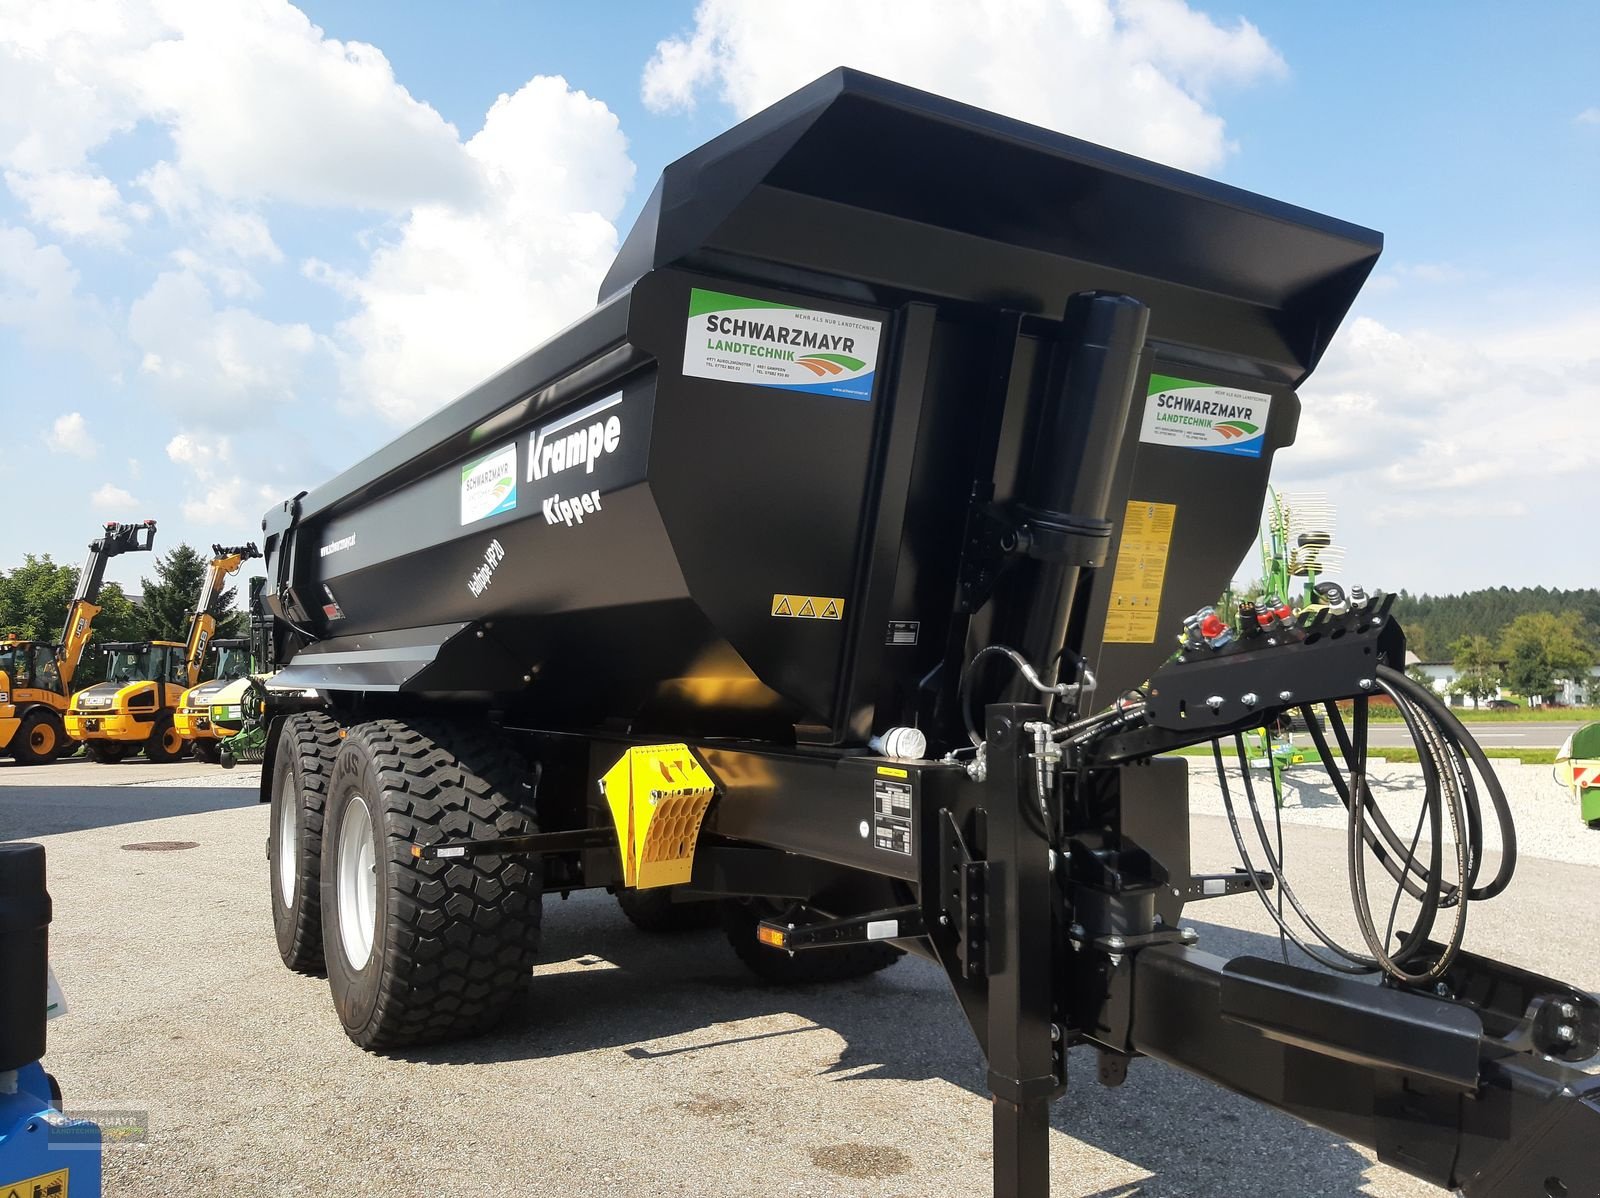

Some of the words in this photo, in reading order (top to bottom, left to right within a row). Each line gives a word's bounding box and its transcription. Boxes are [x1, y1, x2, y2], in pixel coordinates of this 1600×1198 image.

[706, 315, 855, 353] SCHWARZMAYR
[707, 338, 795, 362] LANDTECHNIK
[1157, 394, 1252, 420] SCHWARZMAYR
[1157, 412, 1213, 428] LANDTECHNIK
[527, 416, 621, 483] Krampe
[466, 462, 509, 491] SCHWARZMAYR
[542, 488, 603, 527] Kipper
[467, 563, 493, 598] Halfpipe
[484, 539, 505, 570] HP20
[75, 617, 85, 638] JCB
[197, 630, 208, 659] JCB
